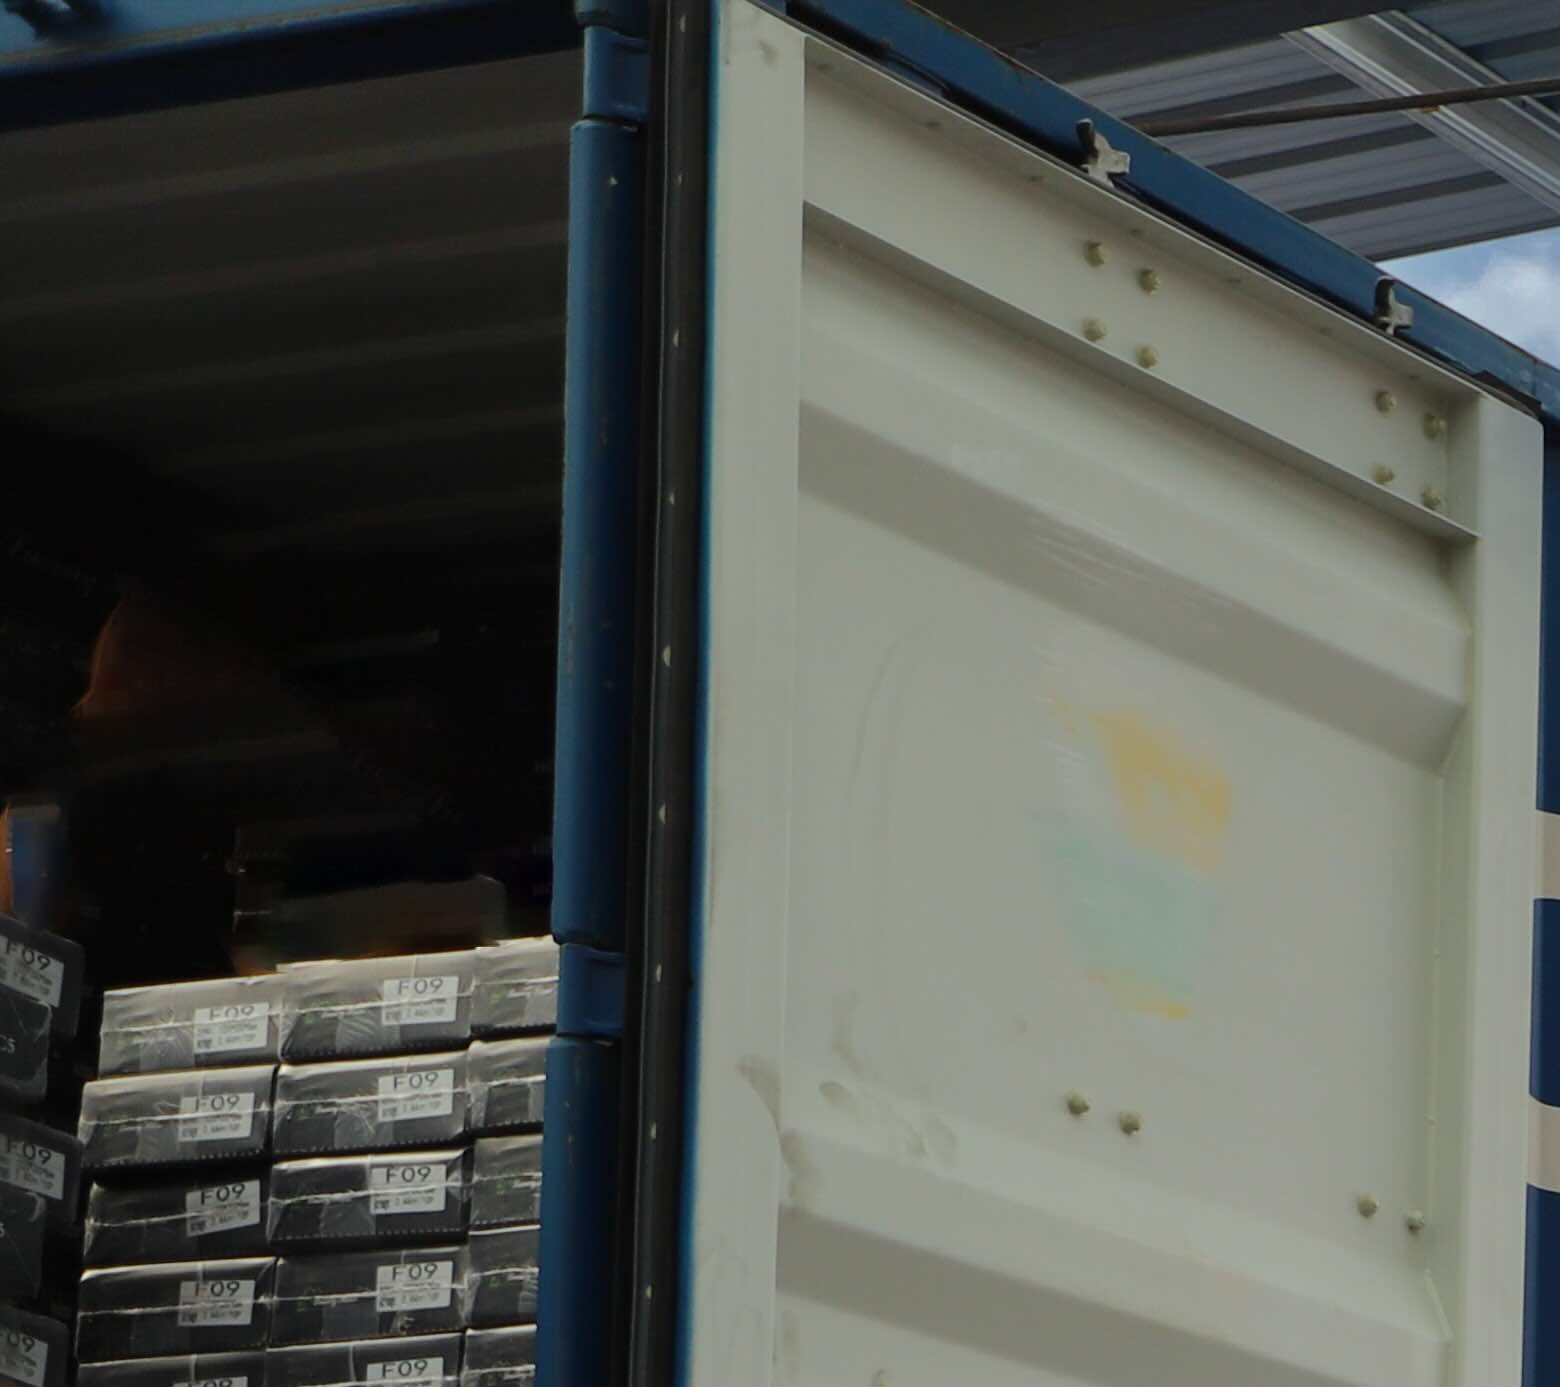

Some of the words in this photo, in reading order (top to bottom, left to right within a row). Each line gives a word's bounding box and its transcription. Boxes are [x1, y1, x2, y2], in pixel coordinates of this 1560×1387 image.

[397, 977, 443, 995] F09
[210, 1002, 255, 1017] F09
[393, 1072, 439, 1089] F09
[195, 1093, 240, 1111] F09
[384, 1166, 430, 1184] F09
[200, 1184, 245, 1202] F09
[391, 1263, 437, 1281] F09
[195, 1280, 240, 1298] F09
[382, 1360, 428, 1378] F09
